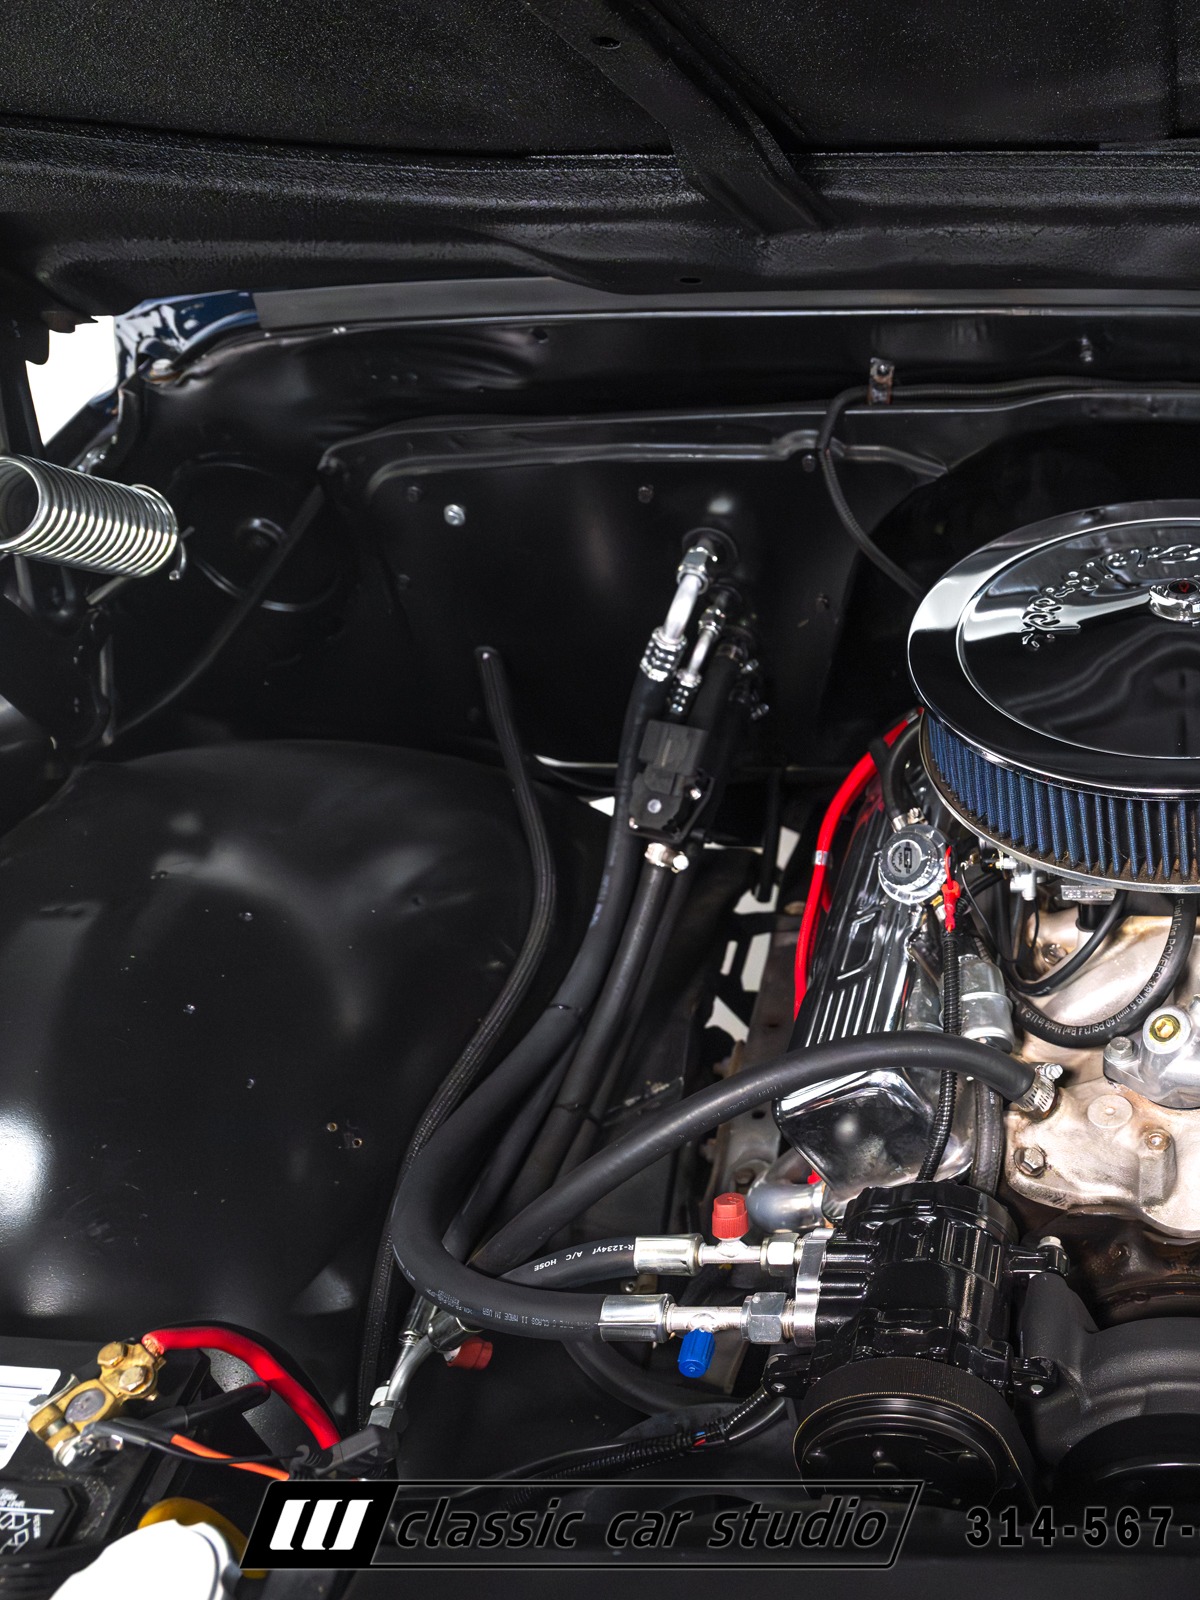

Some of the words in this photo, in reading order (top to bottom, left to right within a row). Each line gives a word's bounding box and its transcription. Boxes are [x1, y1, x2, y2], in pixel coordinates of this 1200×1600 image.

[592, 1244, 635, 1255] R-1234yf
[565, 1251, 584, 1261] A/C
[534, 1258, 557, 1272] HOSE
